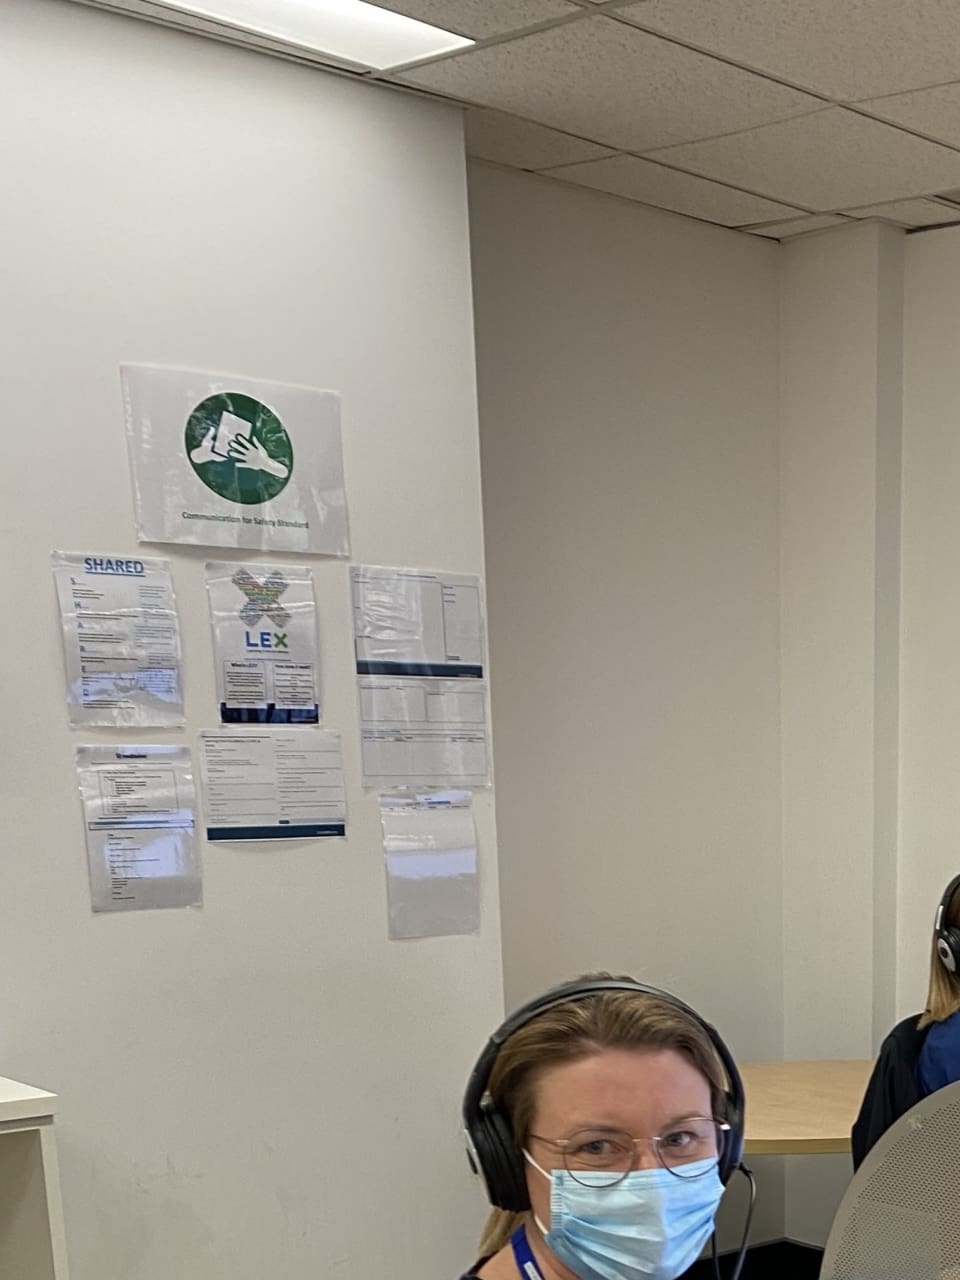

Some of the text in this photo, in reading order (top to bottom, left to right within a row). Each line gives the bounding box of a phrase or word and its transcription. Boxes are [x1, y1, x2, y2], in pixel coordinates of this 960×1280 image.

[181, 510, 241, 523] Communication
[277, 519, 309, 529] Standard
[84, 557, 144, 574] SHARED
[245, 631, 288, 648] LEX
